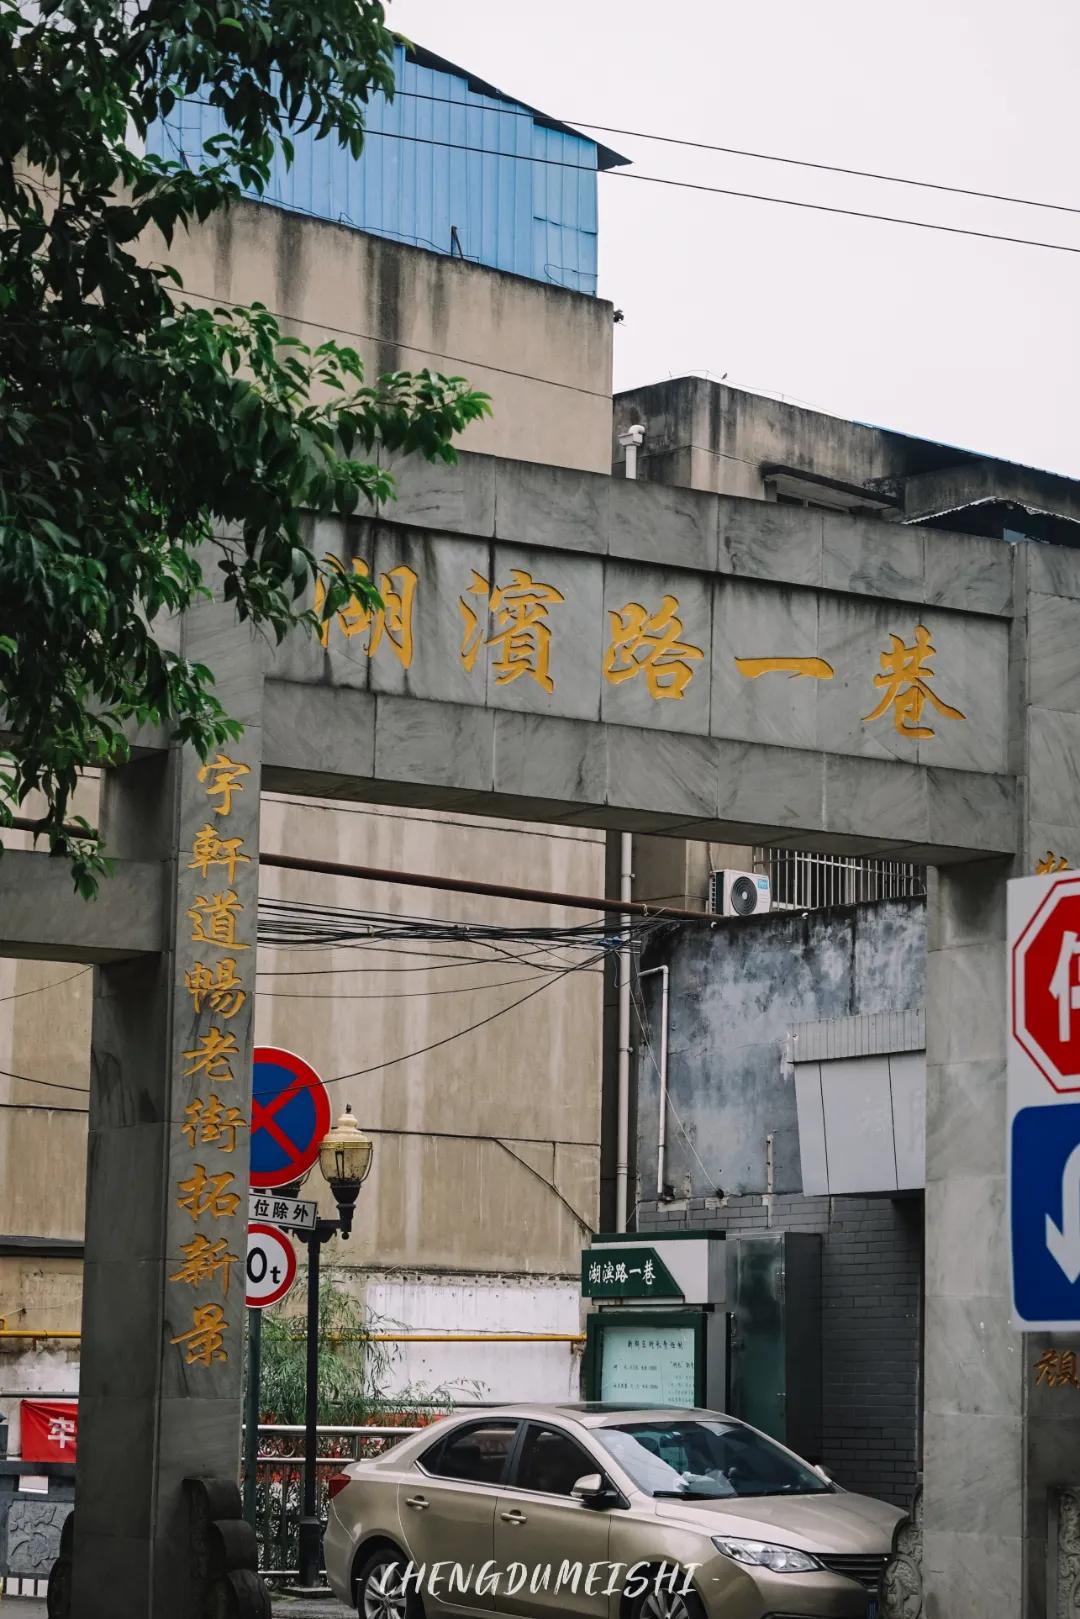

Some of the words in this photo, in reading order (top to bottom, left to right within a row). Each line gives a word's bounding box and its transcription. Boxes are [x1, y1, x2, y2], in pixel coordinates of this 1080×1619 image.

[254, 1200, 308, 1222] 位除外
[588, 1259, 656, 1285] 湖滨路一巷
